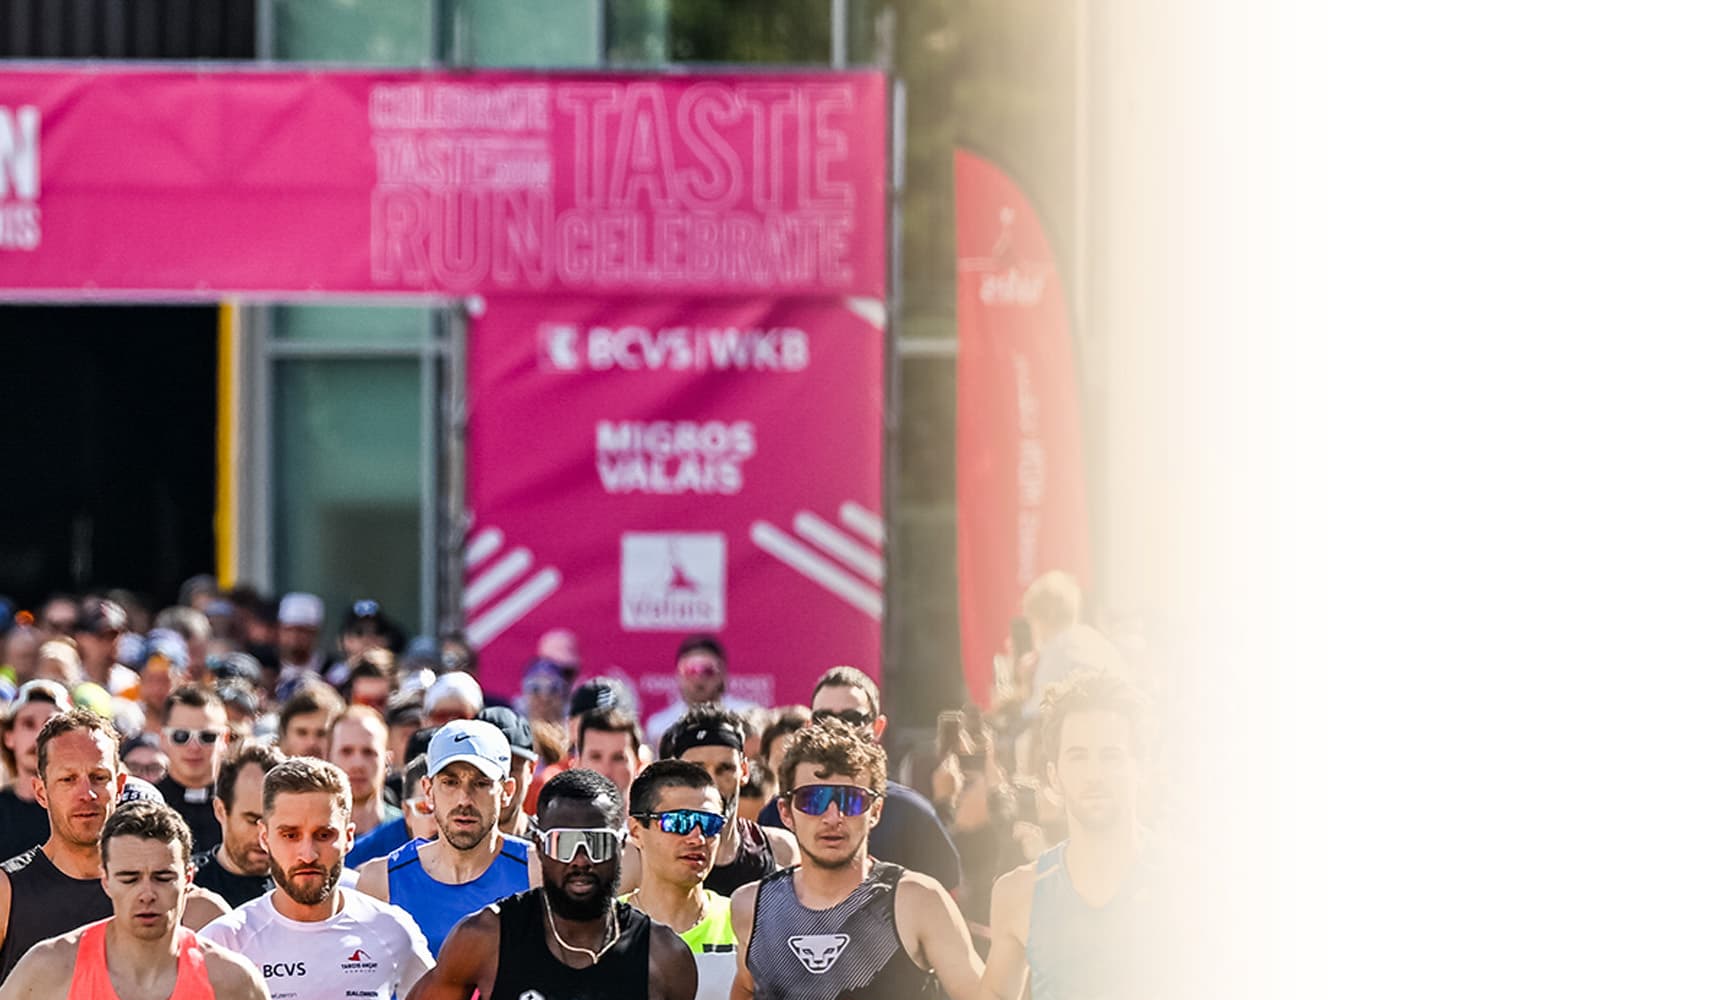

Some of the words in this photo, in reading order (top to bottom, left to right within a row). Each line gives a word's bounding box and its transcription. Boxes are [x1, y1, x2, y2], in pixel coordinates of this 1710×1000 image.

[556, 83, 854, 210] TASTE
[370, 187, 551, 286] RUN
[556, 211, 854, 285] CELEBRATE
[597, 420, 756, 458] MIGROS
[598, 456, 743, 494] VALAIS
[263, 962, 307, 978] BCVS
